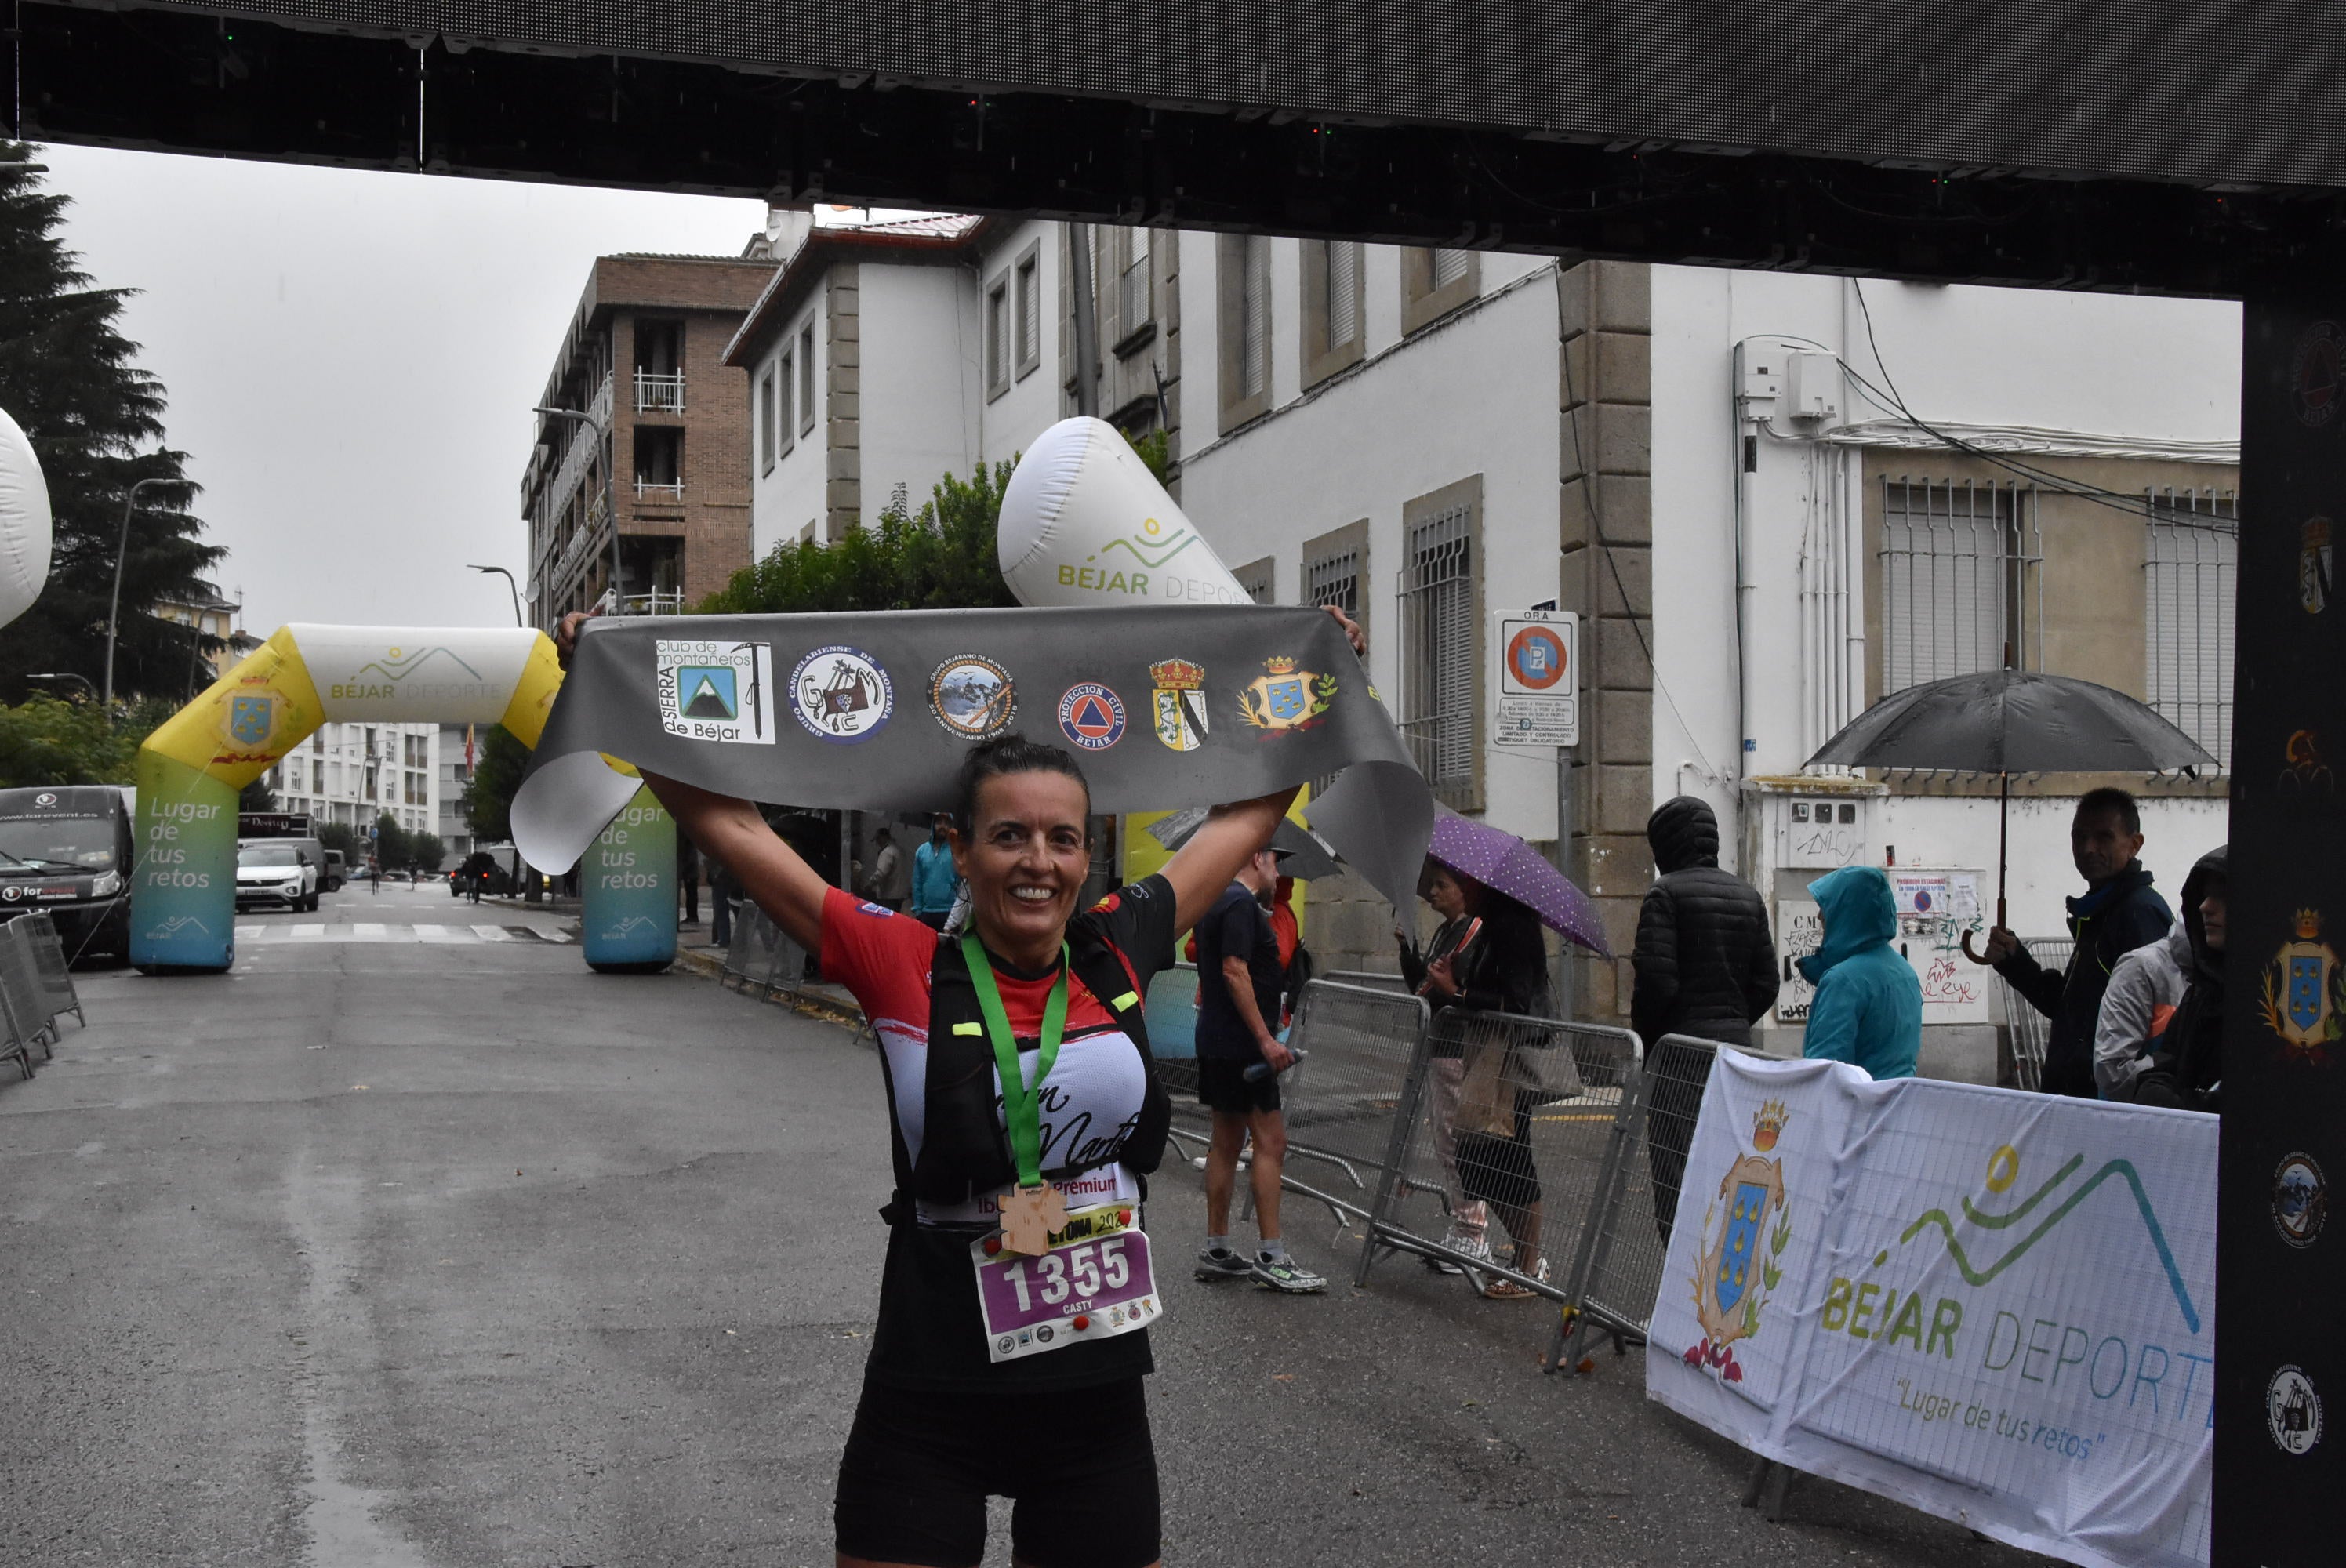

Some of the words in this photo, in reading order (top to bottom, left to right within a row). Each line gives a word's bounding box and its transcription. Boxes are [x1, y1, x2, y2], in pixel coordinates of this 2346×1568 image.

[1059, 555, 1149, 596] BÉJAR
[1523, 611, 1549, 620] ORA
[657, 641, 691, 653] club
[696, 641, 717, 653] de
[657, 652, 750, 666] montañeros
[859, 652, 875, 665] DE
[930, 663, 946, 681] GRUPO
[944, 653, 978, 666] BEJARANO
[789, 645, 852, 699] CANDELARIENSE
[406, 684, 503, 699] DEPORTE
[659, 666, 677, 720] SIERRA
[1061, 686, 1104, 723] PROTECCION
[1109, 697, 1124, 727] CIVIL
[665, 720, 688, 734] de
[695, 723, 740, 742] Béjar
[794, 707, 823, 737] GRUPO
[935, 716, 986, 741] ANIVERSARIO
[1077, 735, 1112, 748] BEJAR
[150, 797, 222, 822] Lugar
[613, 806, 666, 826] ugar
[150, 820, 178, 840] de
[601, 825, 627, 845] de
[149, 845, 186, 864] tus
[601, 848, 636, 867] tus
[148, 869, 210, 888] retos
[601, 873, 658, 889] retos
[1004, 1238, 1129, 1312] 1355
[1062, 1299, 1093, 1315] CASTY
[1821, 1254, 1963, 1359] BÉJAR
[1985, 1310, 2214, 1428] DEPORT
[1964, 1399, 1992, 1431] de
[1996, 1409, 2031, 1443] tus
